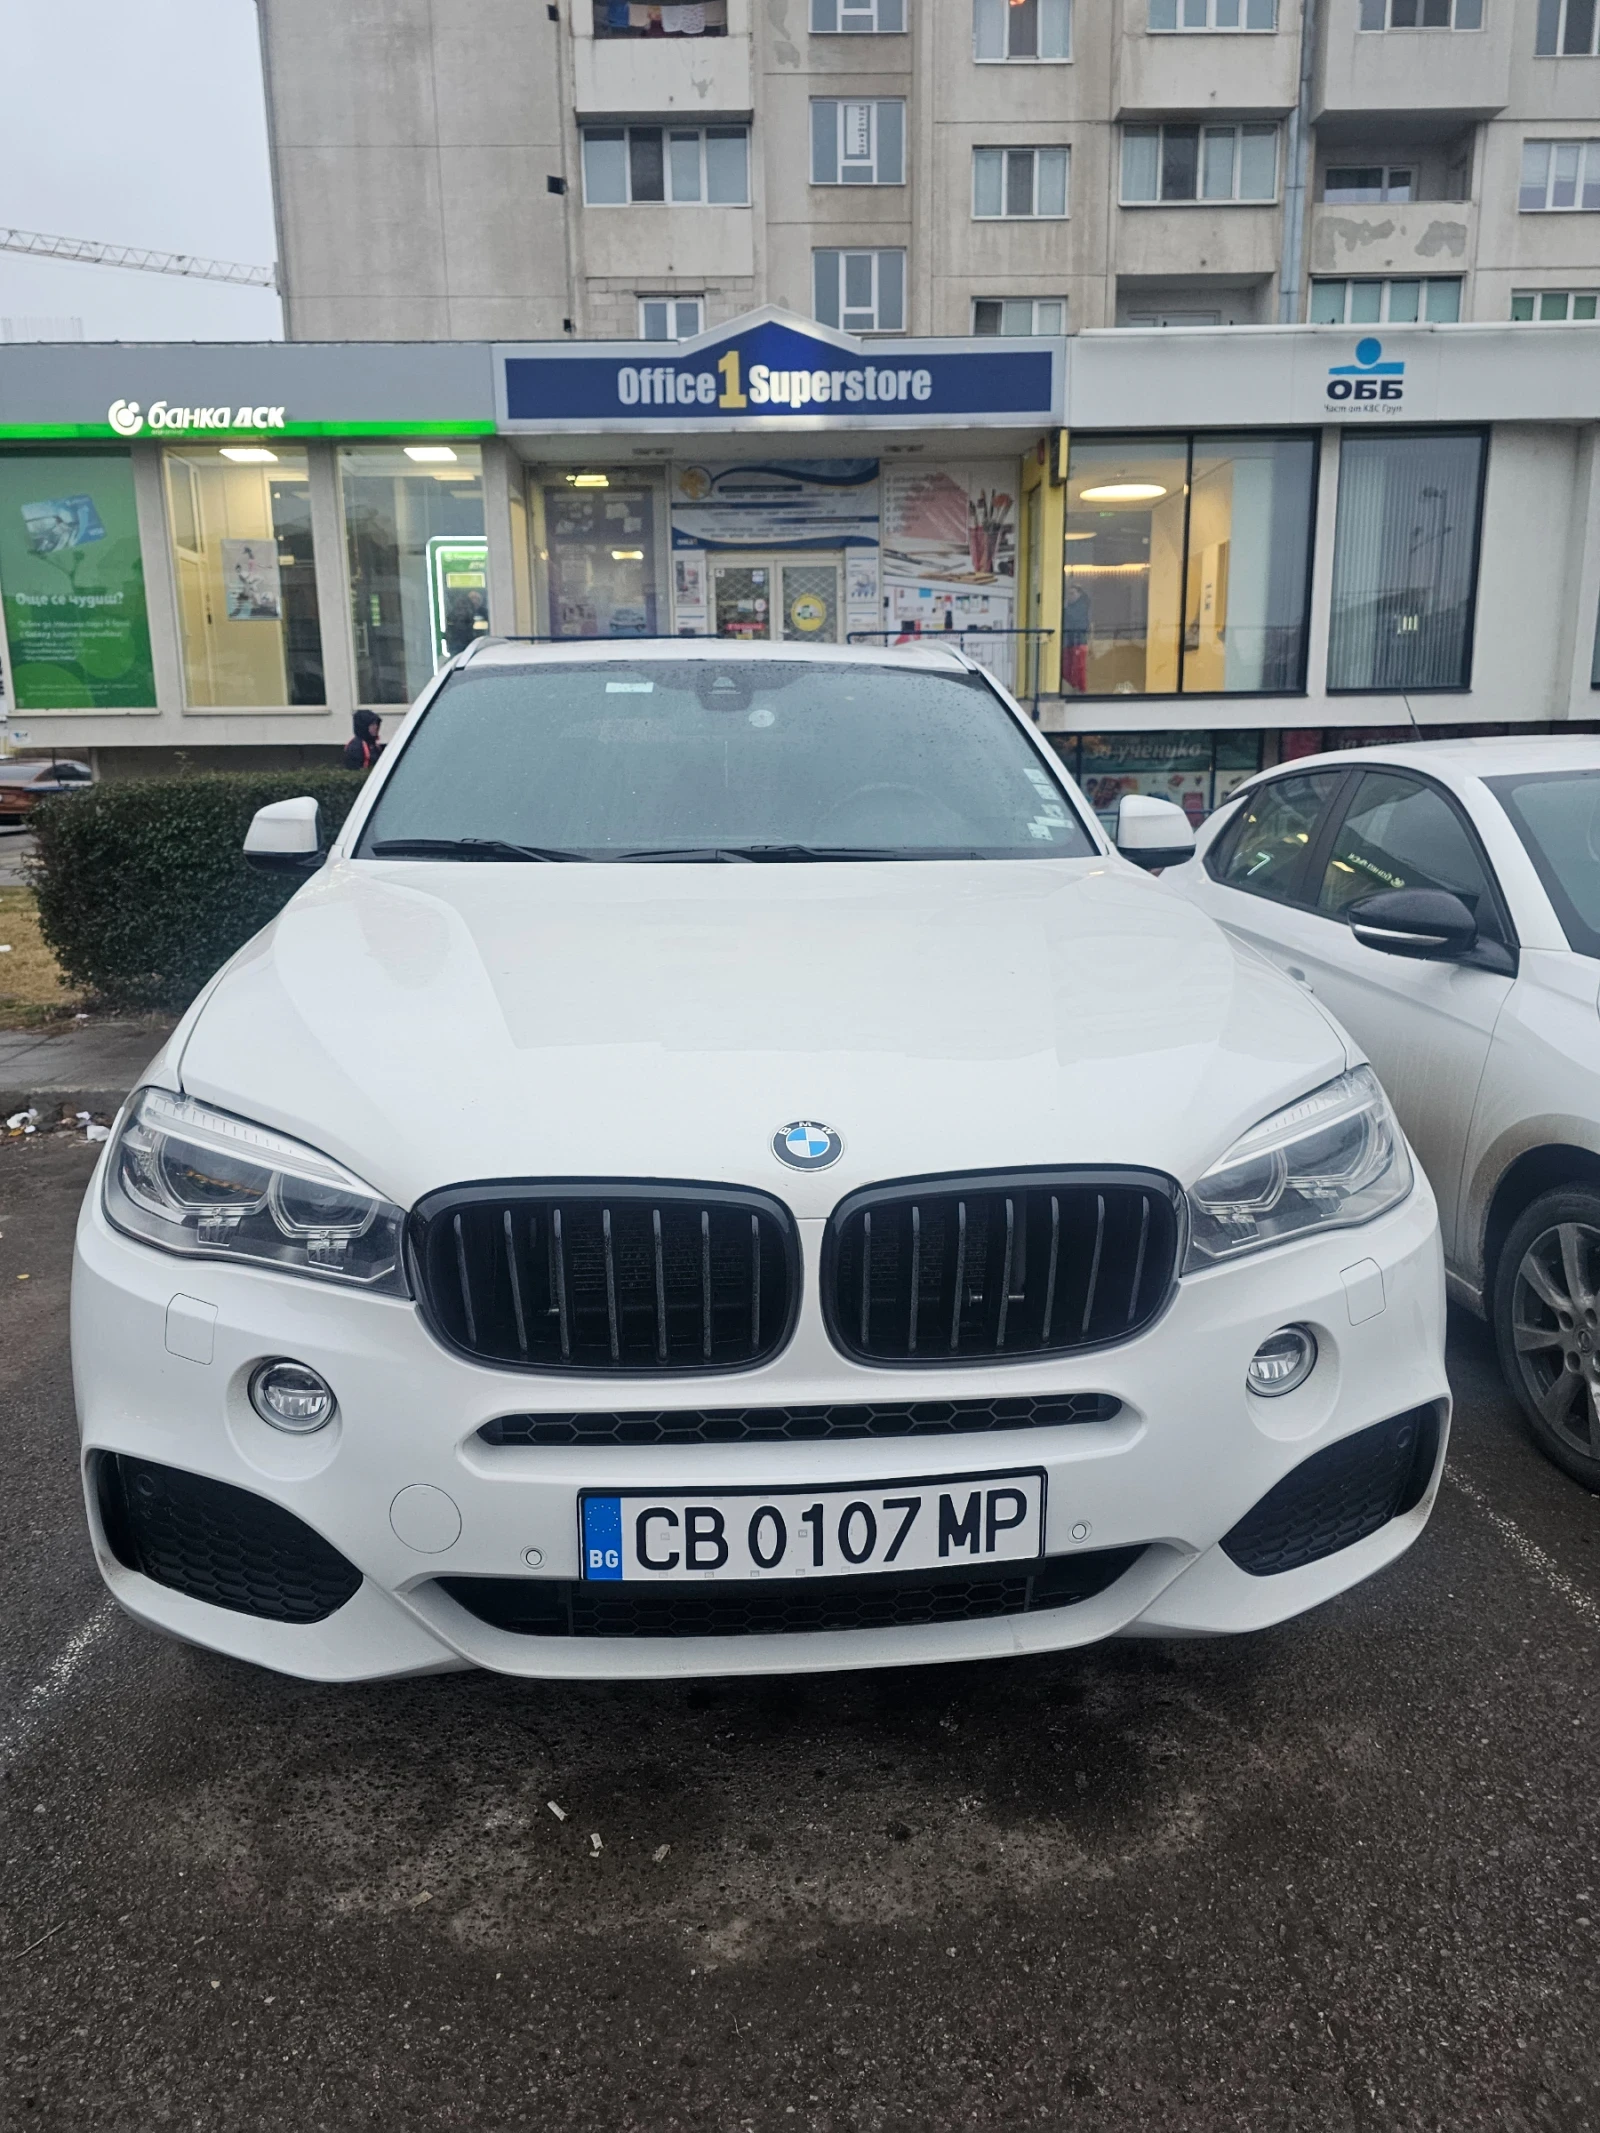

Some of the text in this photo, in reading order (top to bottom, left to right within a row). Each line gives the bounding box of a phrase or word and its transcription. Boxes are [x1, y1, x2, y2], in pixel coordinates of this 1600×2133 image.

[617, 350, 932, 409] Office 1 Superstore
[1326, 380, 1404, 401] ОББ
[147, 400, 231, 429] банка
[15, 592, 48, 607] Още
[51, 594, 66, 606] се
[779, 1121, 835, 1136] BMW
[635, 1487, 1028, 1572] CB 0107 MP
[589, 1549, 619, 1569] BG
